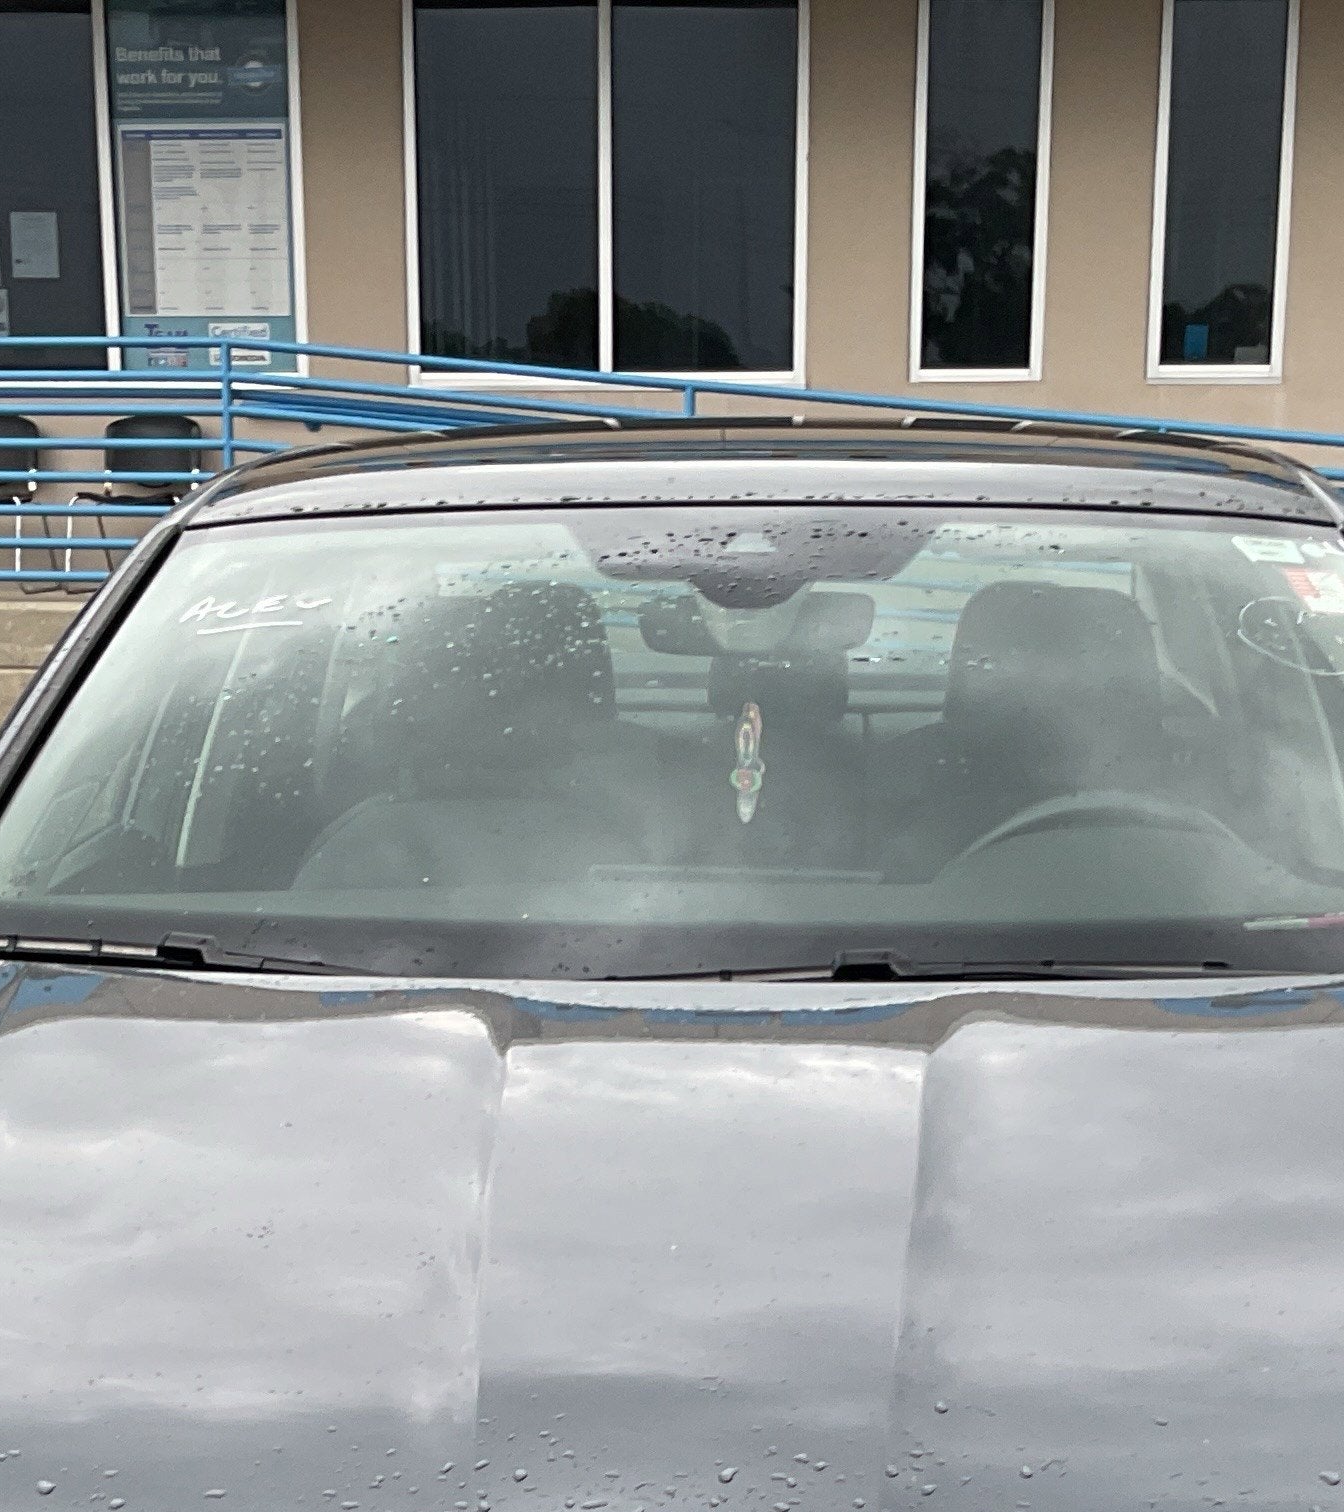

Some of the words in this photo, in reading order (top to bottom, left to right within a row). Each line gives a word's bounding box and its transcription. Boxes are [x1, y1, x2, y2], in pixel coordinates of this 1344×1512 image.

[115, 47, 184, 62] Benefits
[189, 46, 221, 61] that
[116, 70, 157, 84] work
[161, 69, 184, 84] for
